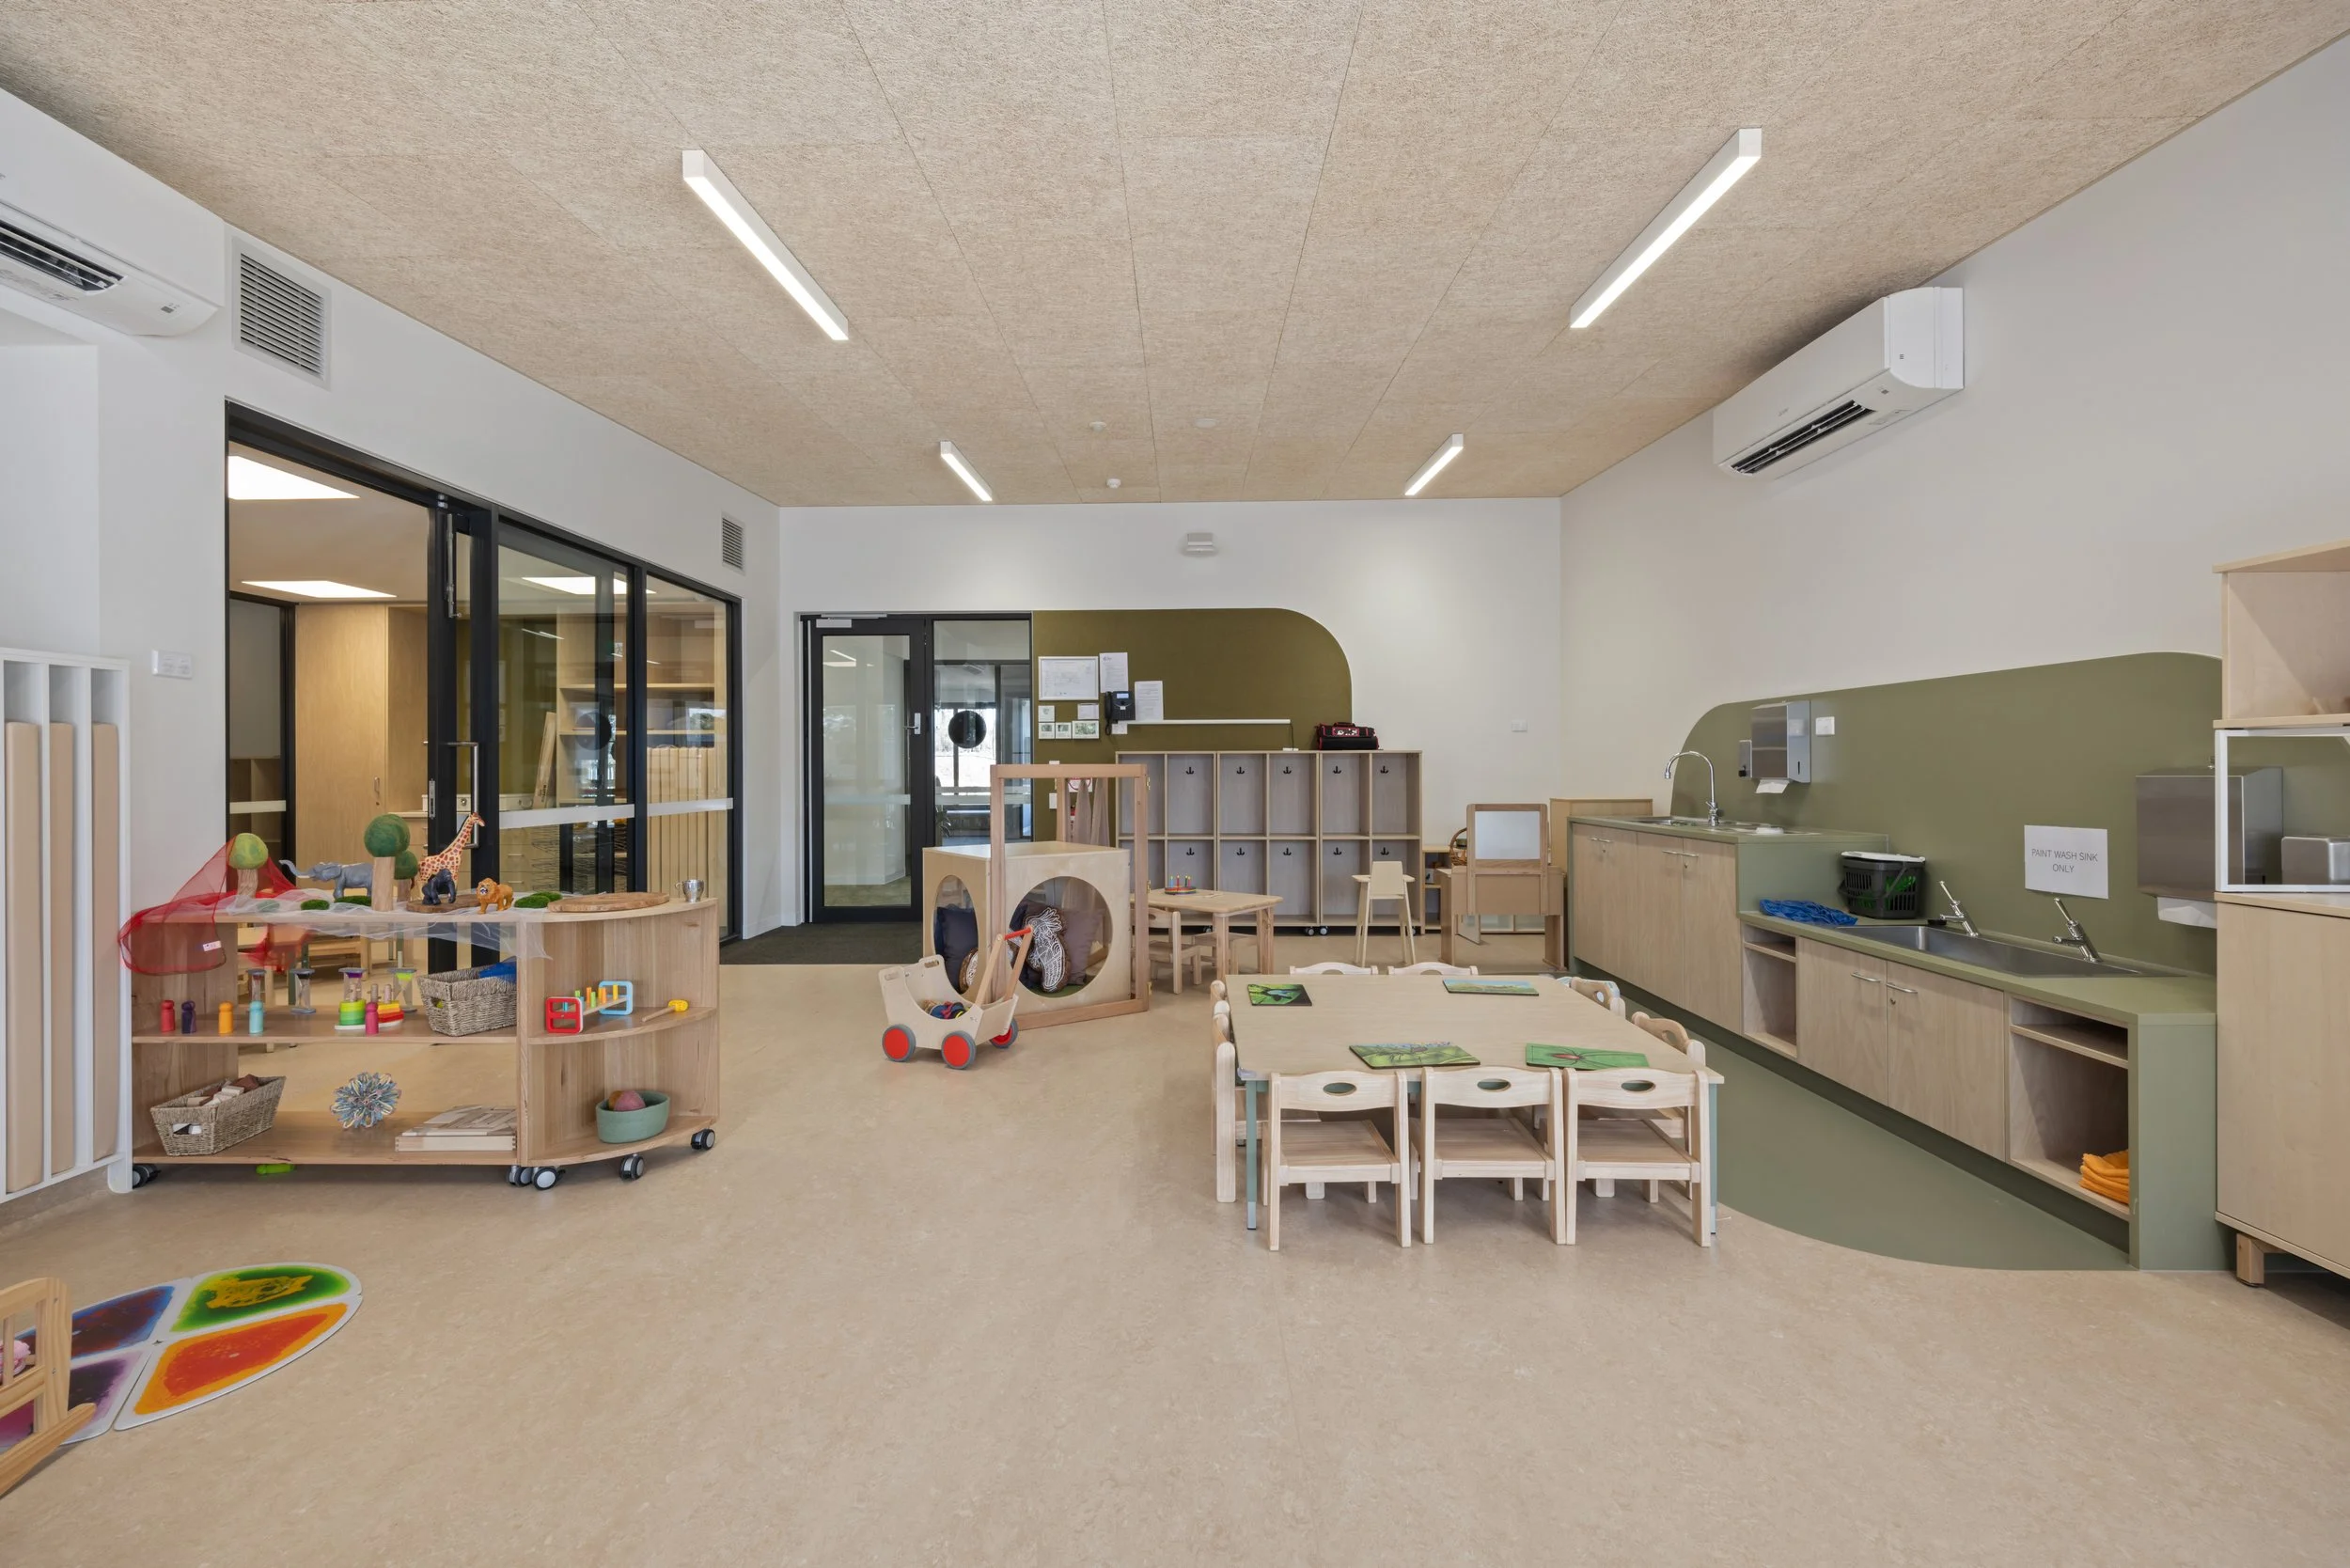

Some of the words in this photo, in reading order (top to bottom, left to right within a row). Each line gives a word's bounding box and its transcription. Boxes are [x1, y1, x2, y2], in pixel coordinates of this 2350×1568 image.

[2031, 848, 2052, 857] PAINT
[2053, 850, 2077, 860] WASH
[2079, 852, 2098, 862] SINK
[2052, 863, 2075, 872] ONLY
